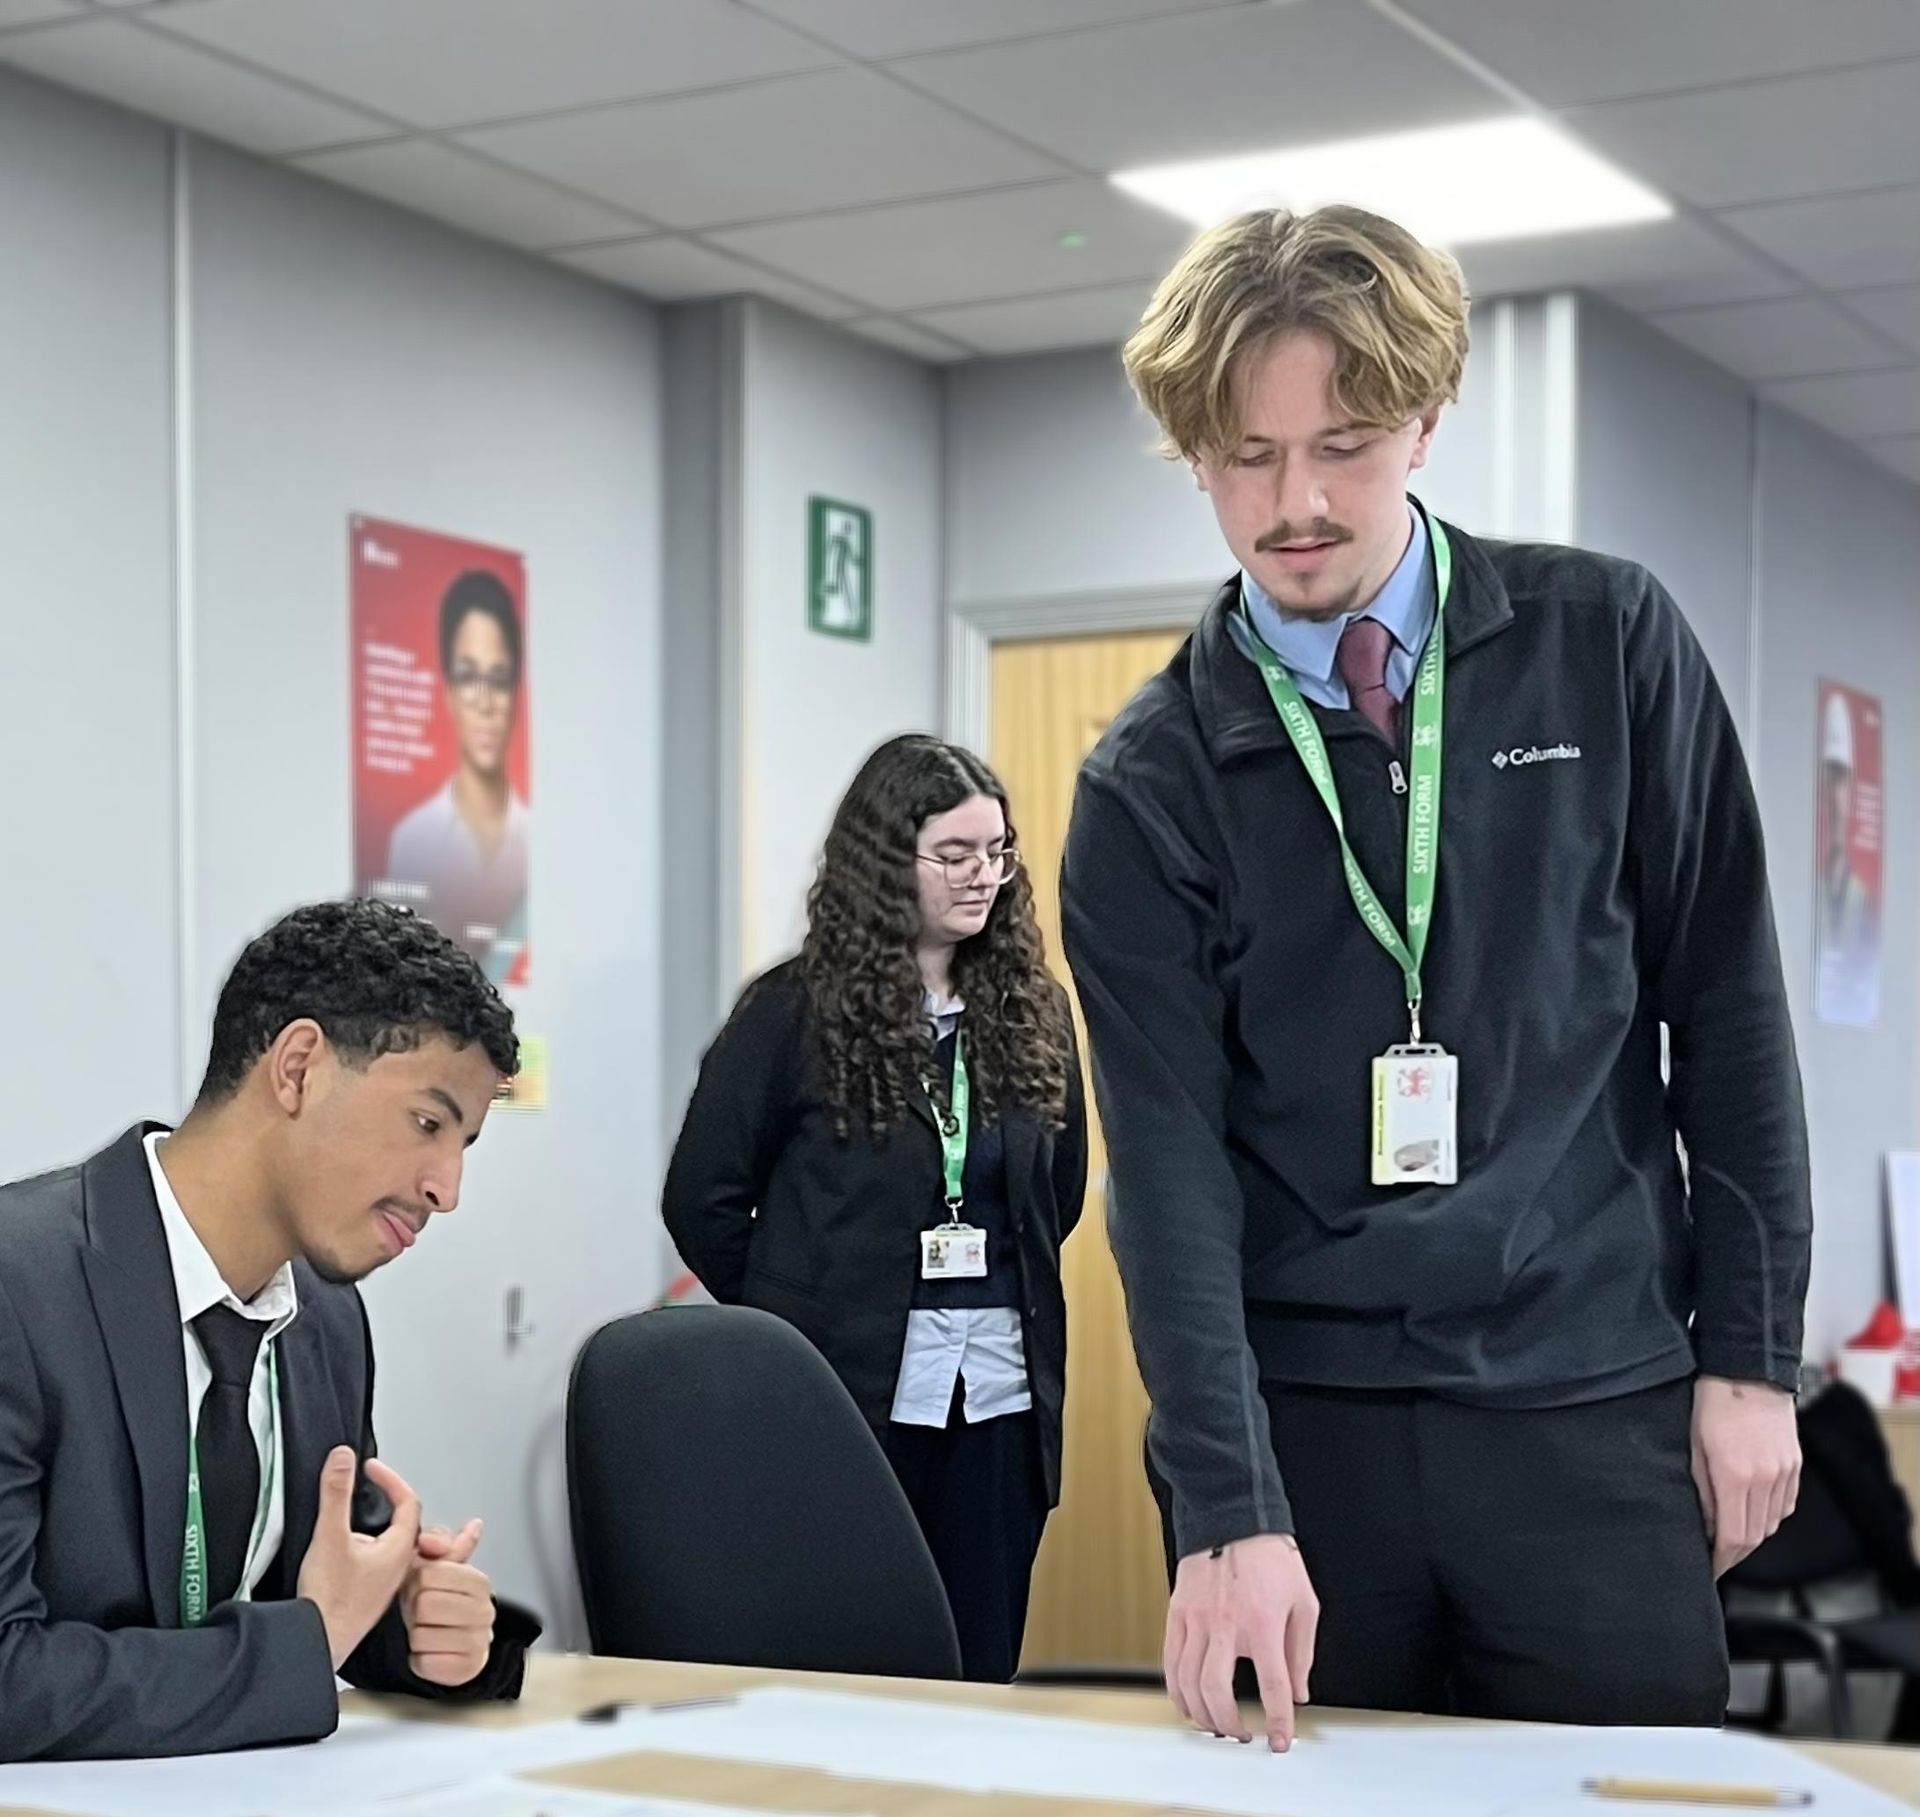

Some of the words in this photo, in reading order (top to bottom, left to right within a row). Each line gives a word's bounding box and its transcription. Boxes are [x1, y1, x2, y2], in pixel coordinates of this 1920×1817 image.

[1420, 651, 1437, 695] SIXTH
[1282, 701, 1312, 738] SIXTH
[1302, 739, 1328, 784] FORM
[1509, 743, 1581, 765] Columbia
[1415, 774, 1432, 823] FORM
[1412, 828, 1430, 874] SIXTH
[1363, 902, 1396, 947] FORM
[185, 1524, 199, 1570] SIXTH
[186, 1574, 201, 1621] FORM
